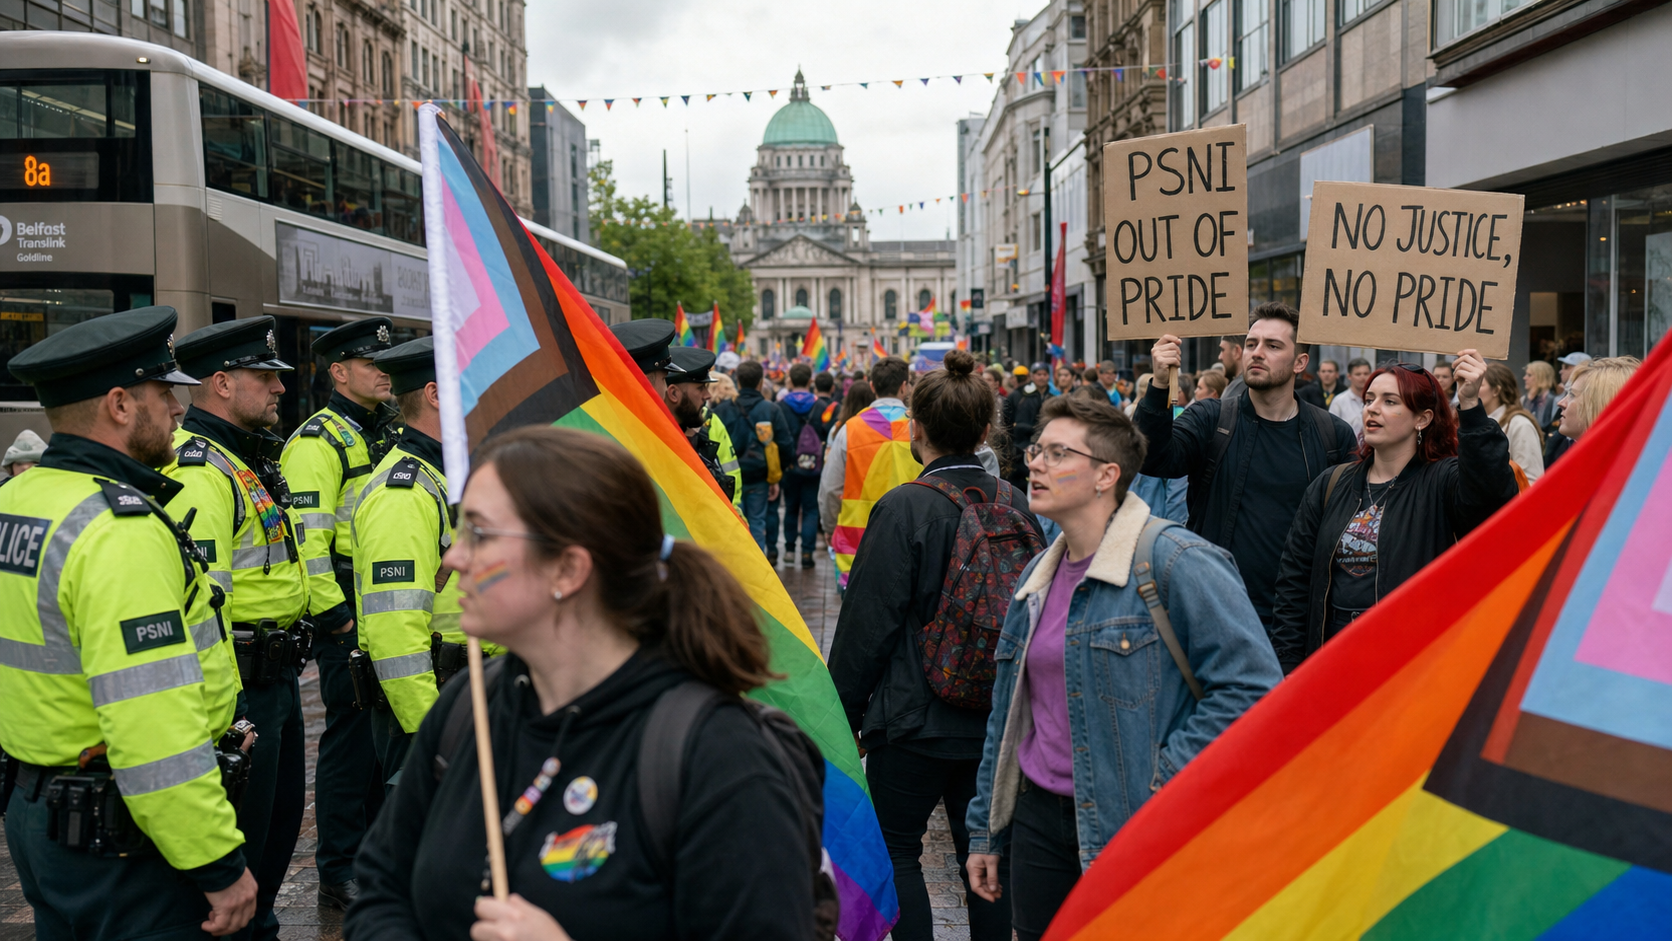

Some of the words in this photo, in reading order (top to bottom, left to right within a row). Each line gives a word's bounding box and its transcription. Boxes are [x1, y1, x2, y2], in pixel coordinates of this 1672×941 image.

[24, 155, 51, 187] 8a
[1128, 142, 1236, 201] PSNI
[17, 222, 66, 236] Belfast
[17, 237, 66, 248] Translink
[1113, 214, 1180, 264] OUT
[1193, 210, 1239, 258] OF
[1331, 202, 1386, 251] NO
[1396, 205, 1512, 268] JUSTICE,
[17, 253, 53, 262] Goldline
[1120, 272, 1232, 325] PRIDE
[1322, 268, 1377, 318] NO
[1392, 272, 1499, 335] PRIDE
[293, 495, 313, 505] PSNI
[0, 521, 44, 568] LICE
[380, 566, 406, 578] PSNI
[136, 620, 174, 642] PSNI
